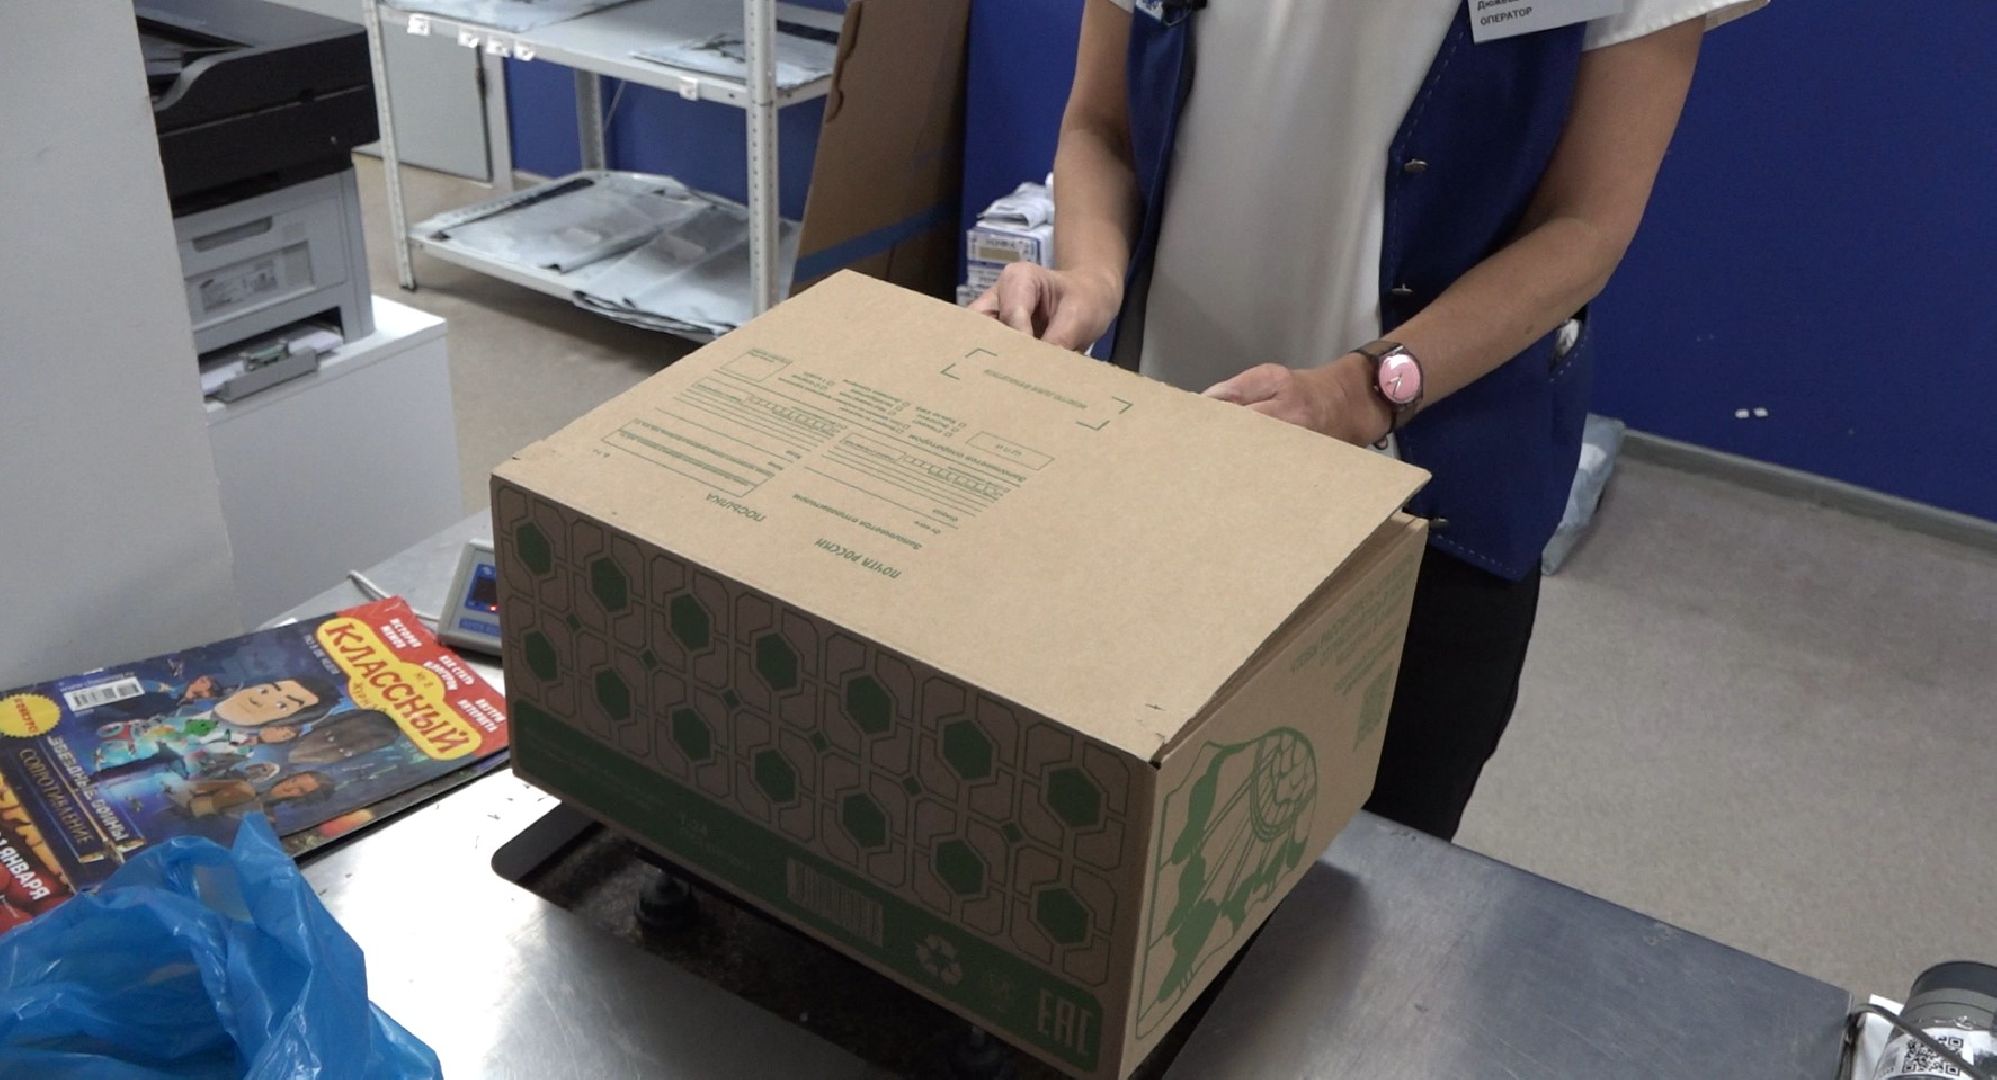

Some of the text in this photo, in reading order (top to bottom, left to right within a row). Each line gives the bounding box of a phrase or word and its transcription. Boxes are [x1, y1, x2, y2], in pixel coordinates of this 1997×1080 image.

[1480, 6, 1532, 25] ОПЕРАТОР
[705, 493, 768, 522] ПОСЫЛКА
[814, 538, 902, 579] ПОЧТА РОССИИ
[324, 622, 470, 754] КЛАССНЫЙ
[20, 748, 95, 843] СОПРОТИВЛЕНИЕ
[0, 847, 50, 900] ЯНВАРЯ
